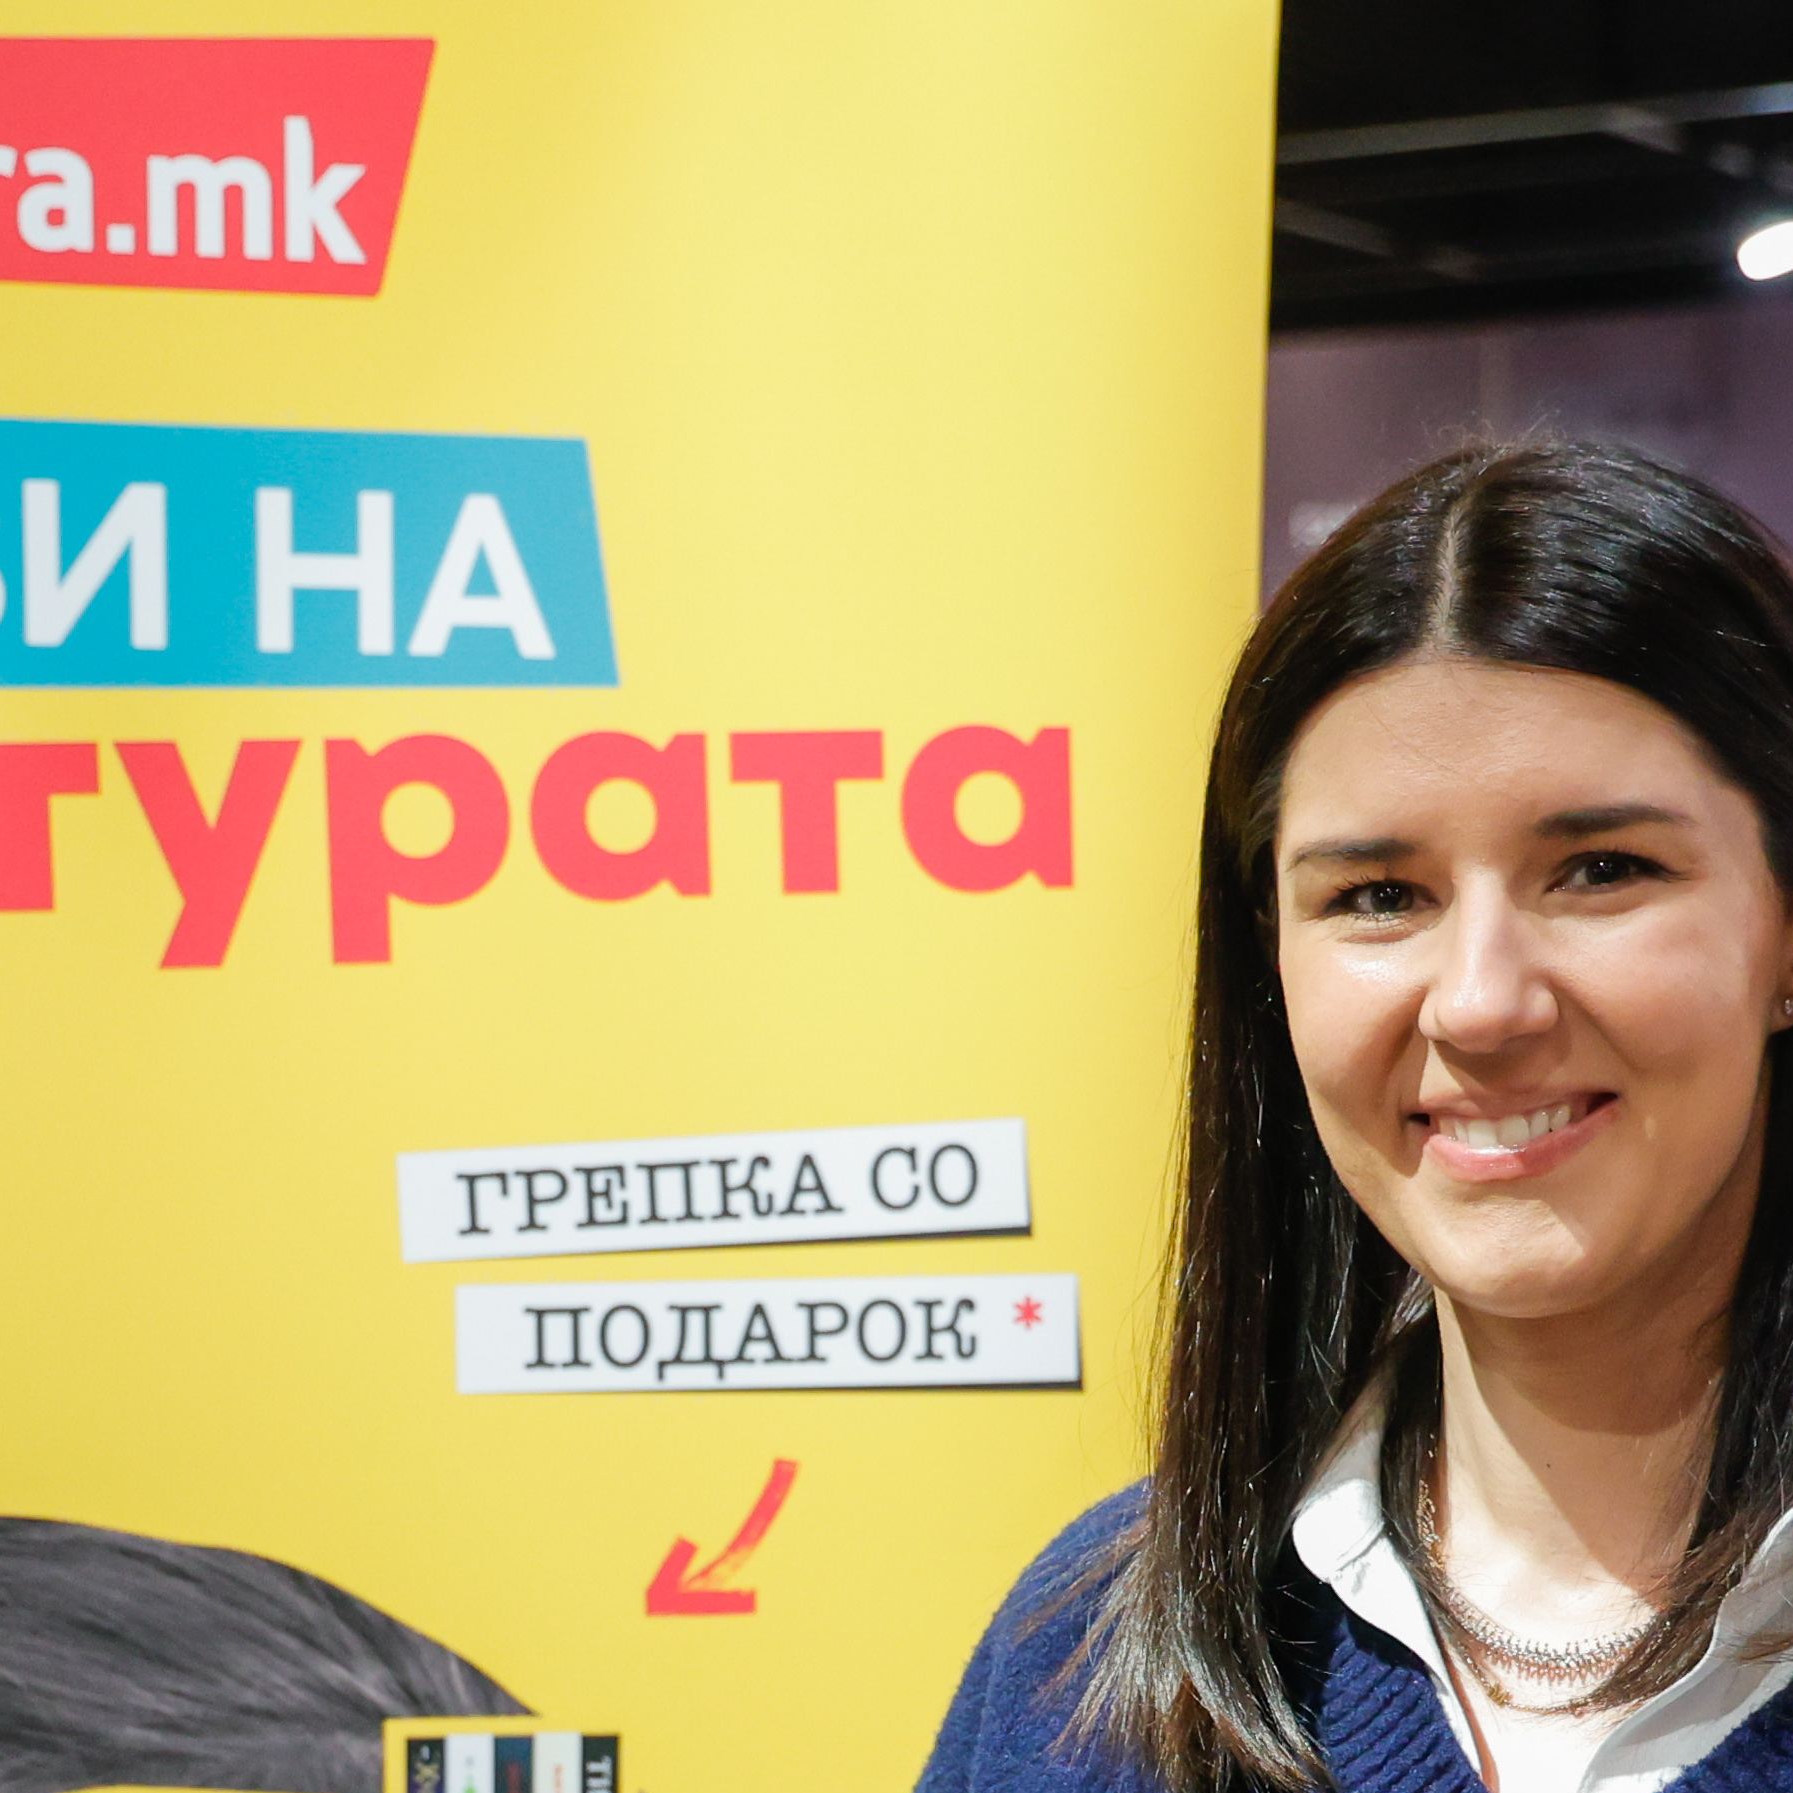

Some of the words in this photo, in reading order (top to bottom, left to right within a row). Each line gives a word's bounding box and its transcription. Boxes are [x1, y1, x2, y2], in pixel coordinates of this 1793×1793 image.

[254, 488, 557, 660] НА
[456, 1154, 844, 1238] ГРЕПКА
[870, 1143, 981, 1211] СО
[524, 1298, 979, 1381] ПОДАРОК
